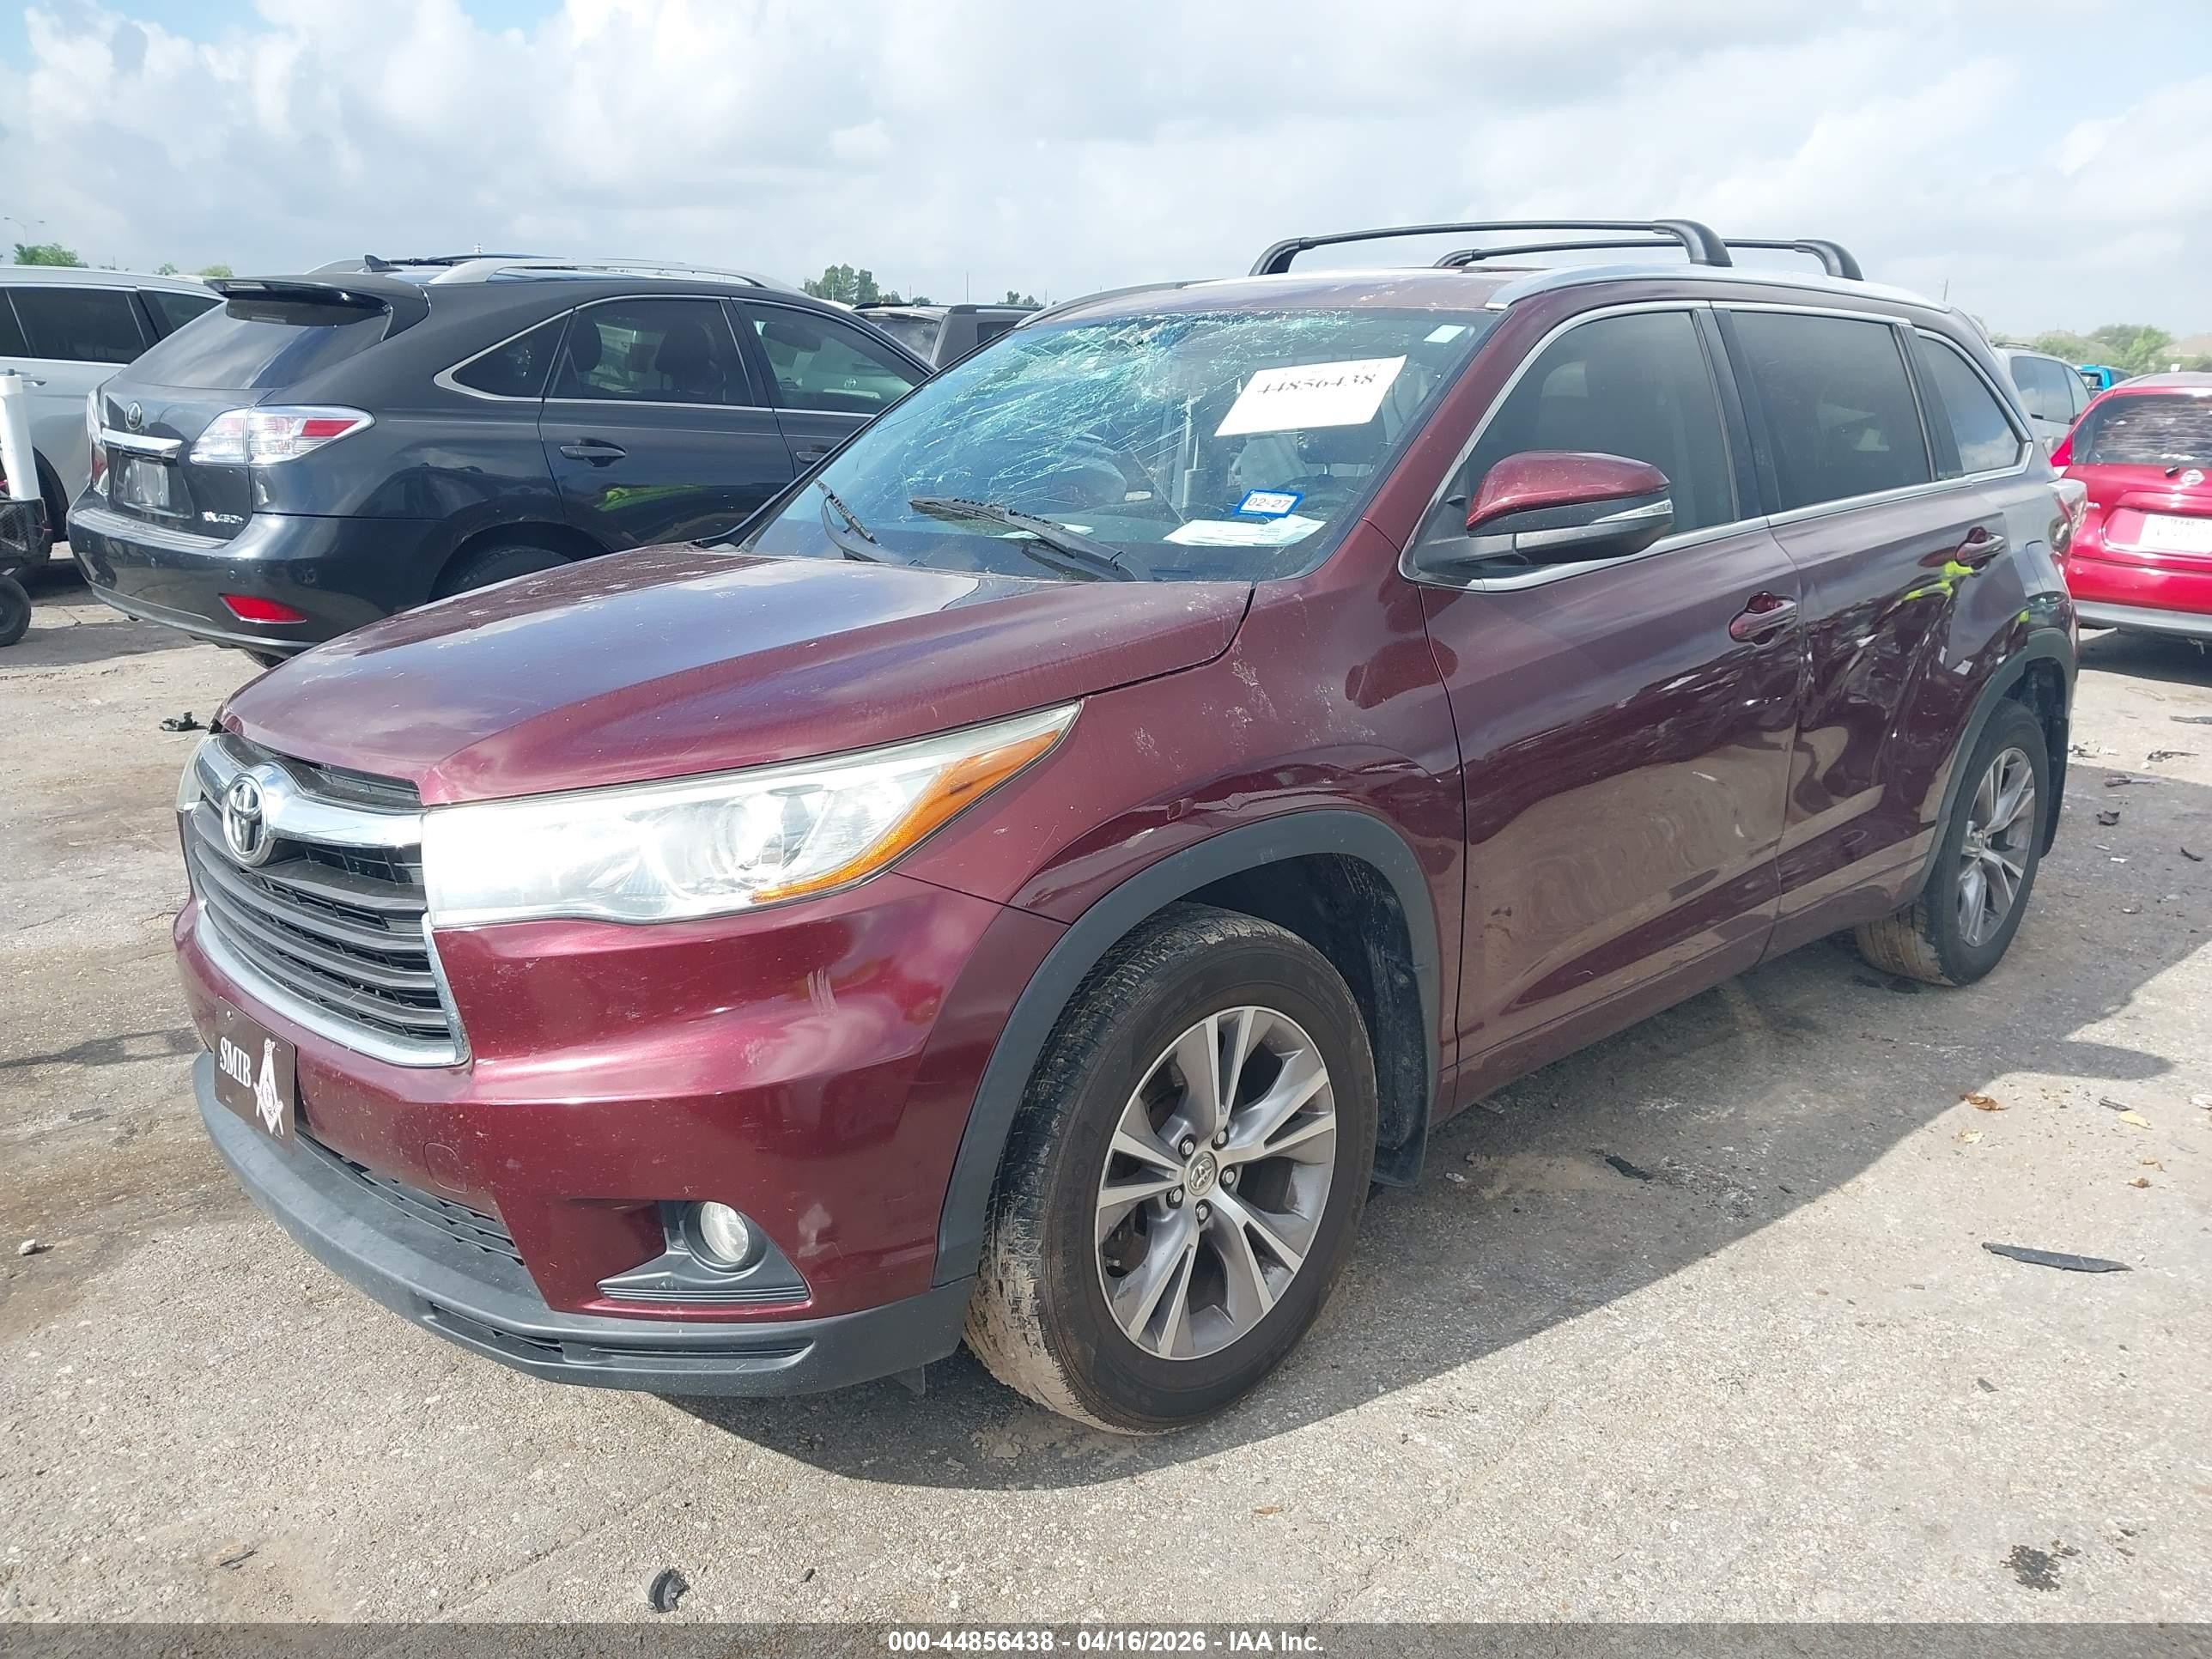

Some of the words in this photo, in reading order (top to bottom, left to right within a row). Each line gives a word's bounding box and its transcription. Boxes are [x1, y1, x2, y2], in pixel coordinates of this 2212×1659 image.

[1256, 373, 1377, 394] 44856438
[1247, 497, 1292, 508] 02-27
[220, 1036, 252, 1088] SMIB
